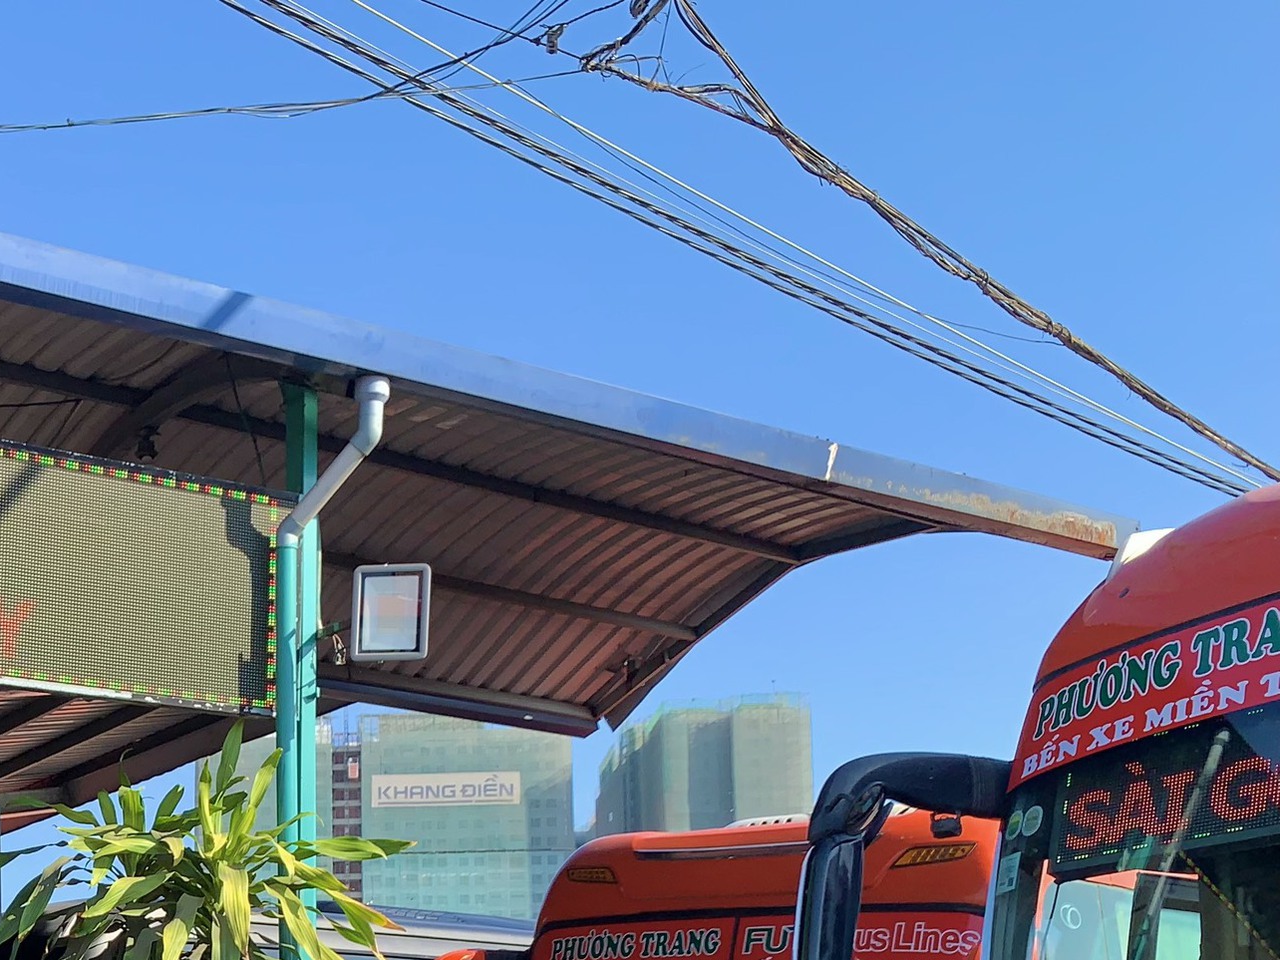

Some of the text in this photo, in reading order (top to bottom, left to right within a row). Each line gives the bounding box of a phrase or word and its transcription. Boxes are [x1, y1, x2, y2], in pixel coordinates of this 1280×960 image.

[1032, 640, 1182, 741] PHƯƠNG
[1021, 733, 1080, 780] BẾN
[1086, 715, 1135, 752] XE
[1143, 679, 1250, 733] MIỀN
[377, 773, 515, 800] KHANG ĐIỀN
[1210, 755, 1280, 822] G
[640, 927, 721, 959] TRANG
[891, 921, 981, 956] Lines
